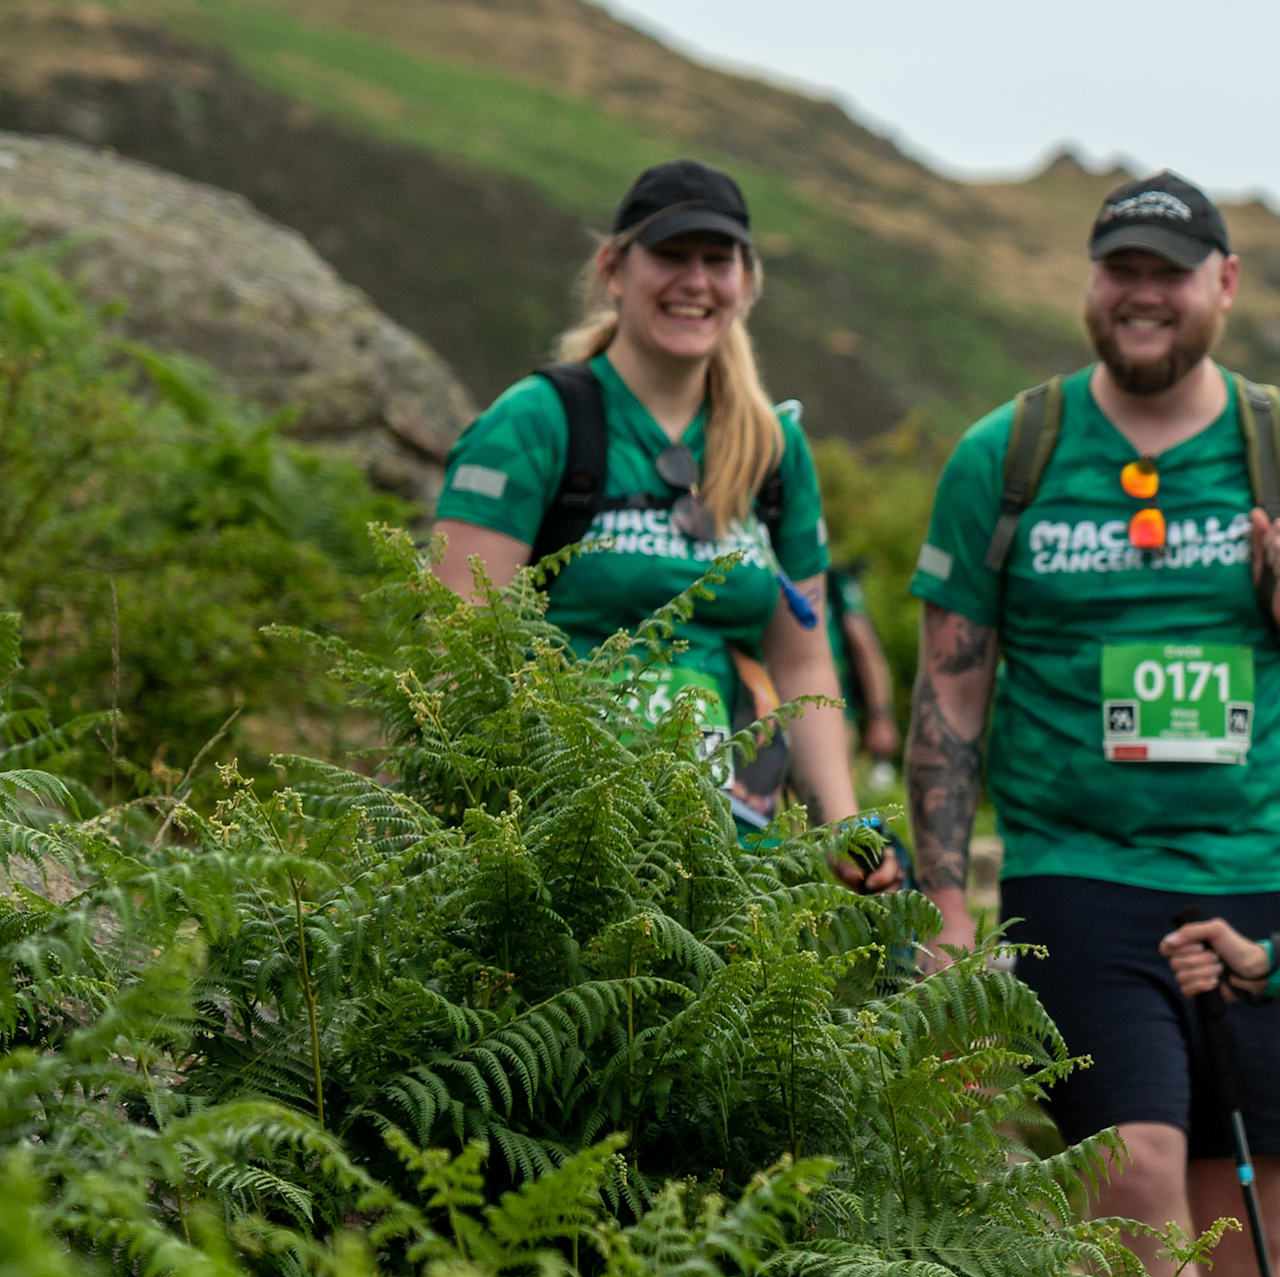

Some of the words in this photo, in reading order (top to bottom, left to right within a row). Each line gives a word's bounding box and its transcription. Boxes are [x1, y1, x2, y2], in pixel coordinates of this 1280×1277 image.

[1029, 513, 1252, 551] MACILLA
[1151, 540, 1250, 569] SUPPOR
[1133, 660, 1231, 703] 0171
